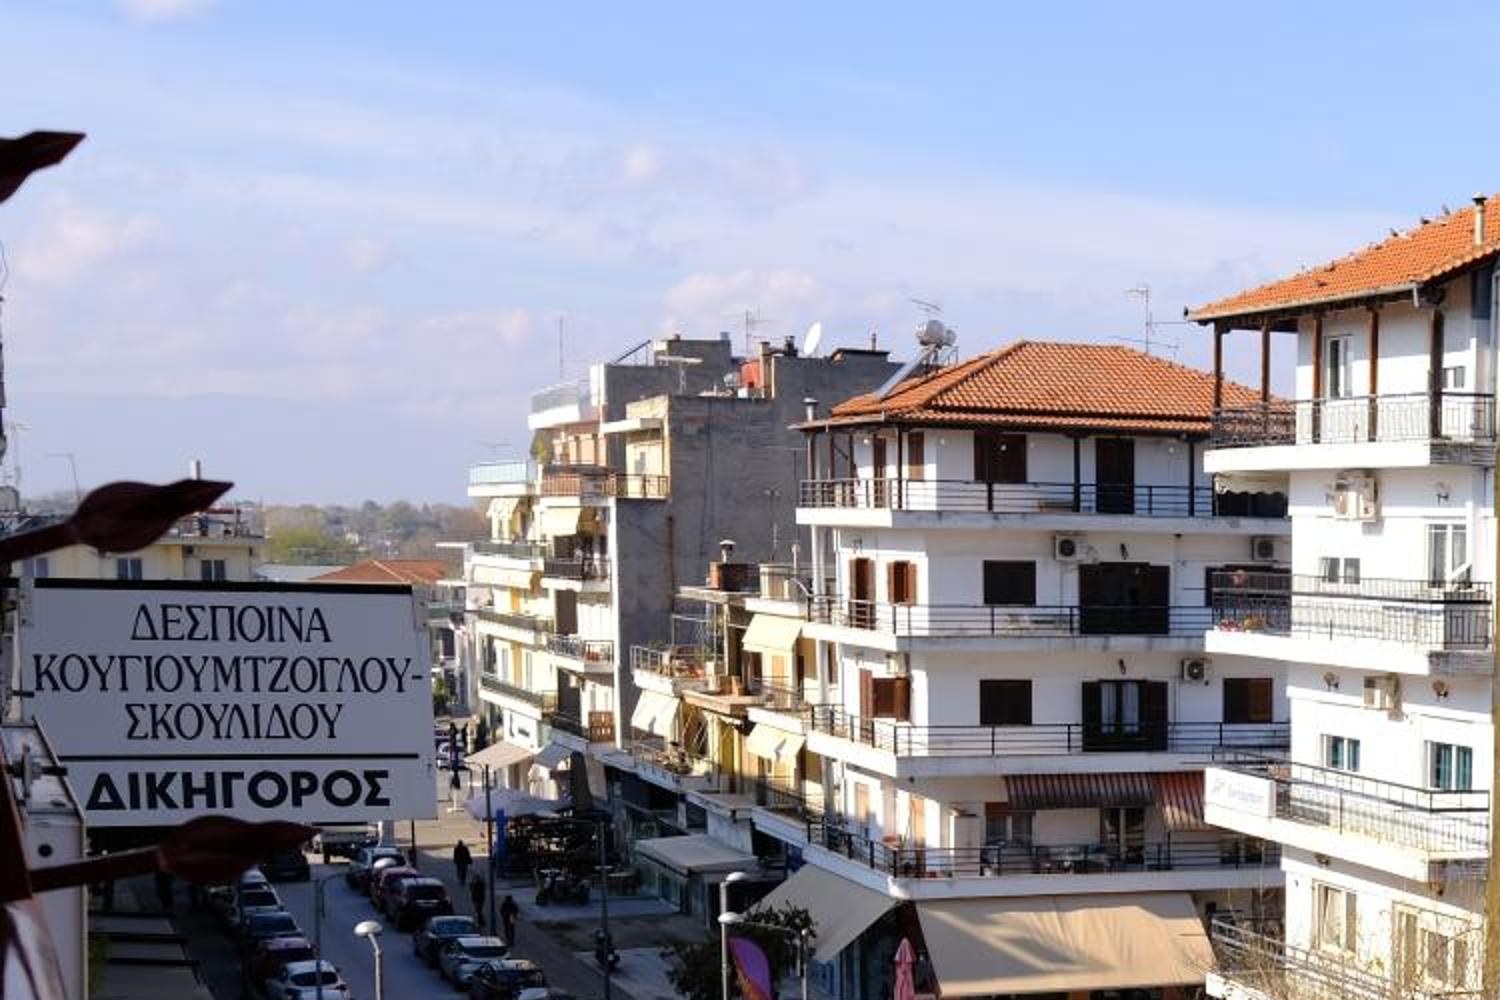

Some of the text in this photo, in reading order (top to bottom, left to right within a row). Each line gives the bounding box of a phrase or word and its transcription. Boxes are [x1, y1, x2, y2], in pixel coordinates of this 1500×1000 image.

[130, 603, 332, 643] ΔΕΣΠΟΙΝΑ
[33, 654, 423, 693] ΚΟΥΓΙΟΥΜΤΖΟΓΛΟΥ-
[125, 703, 343, 741] ΣΚΟΥΛΙΔΟΥ
[85, 769, 391, 811] ΔΙΚΗΓΟΡΟΣ
